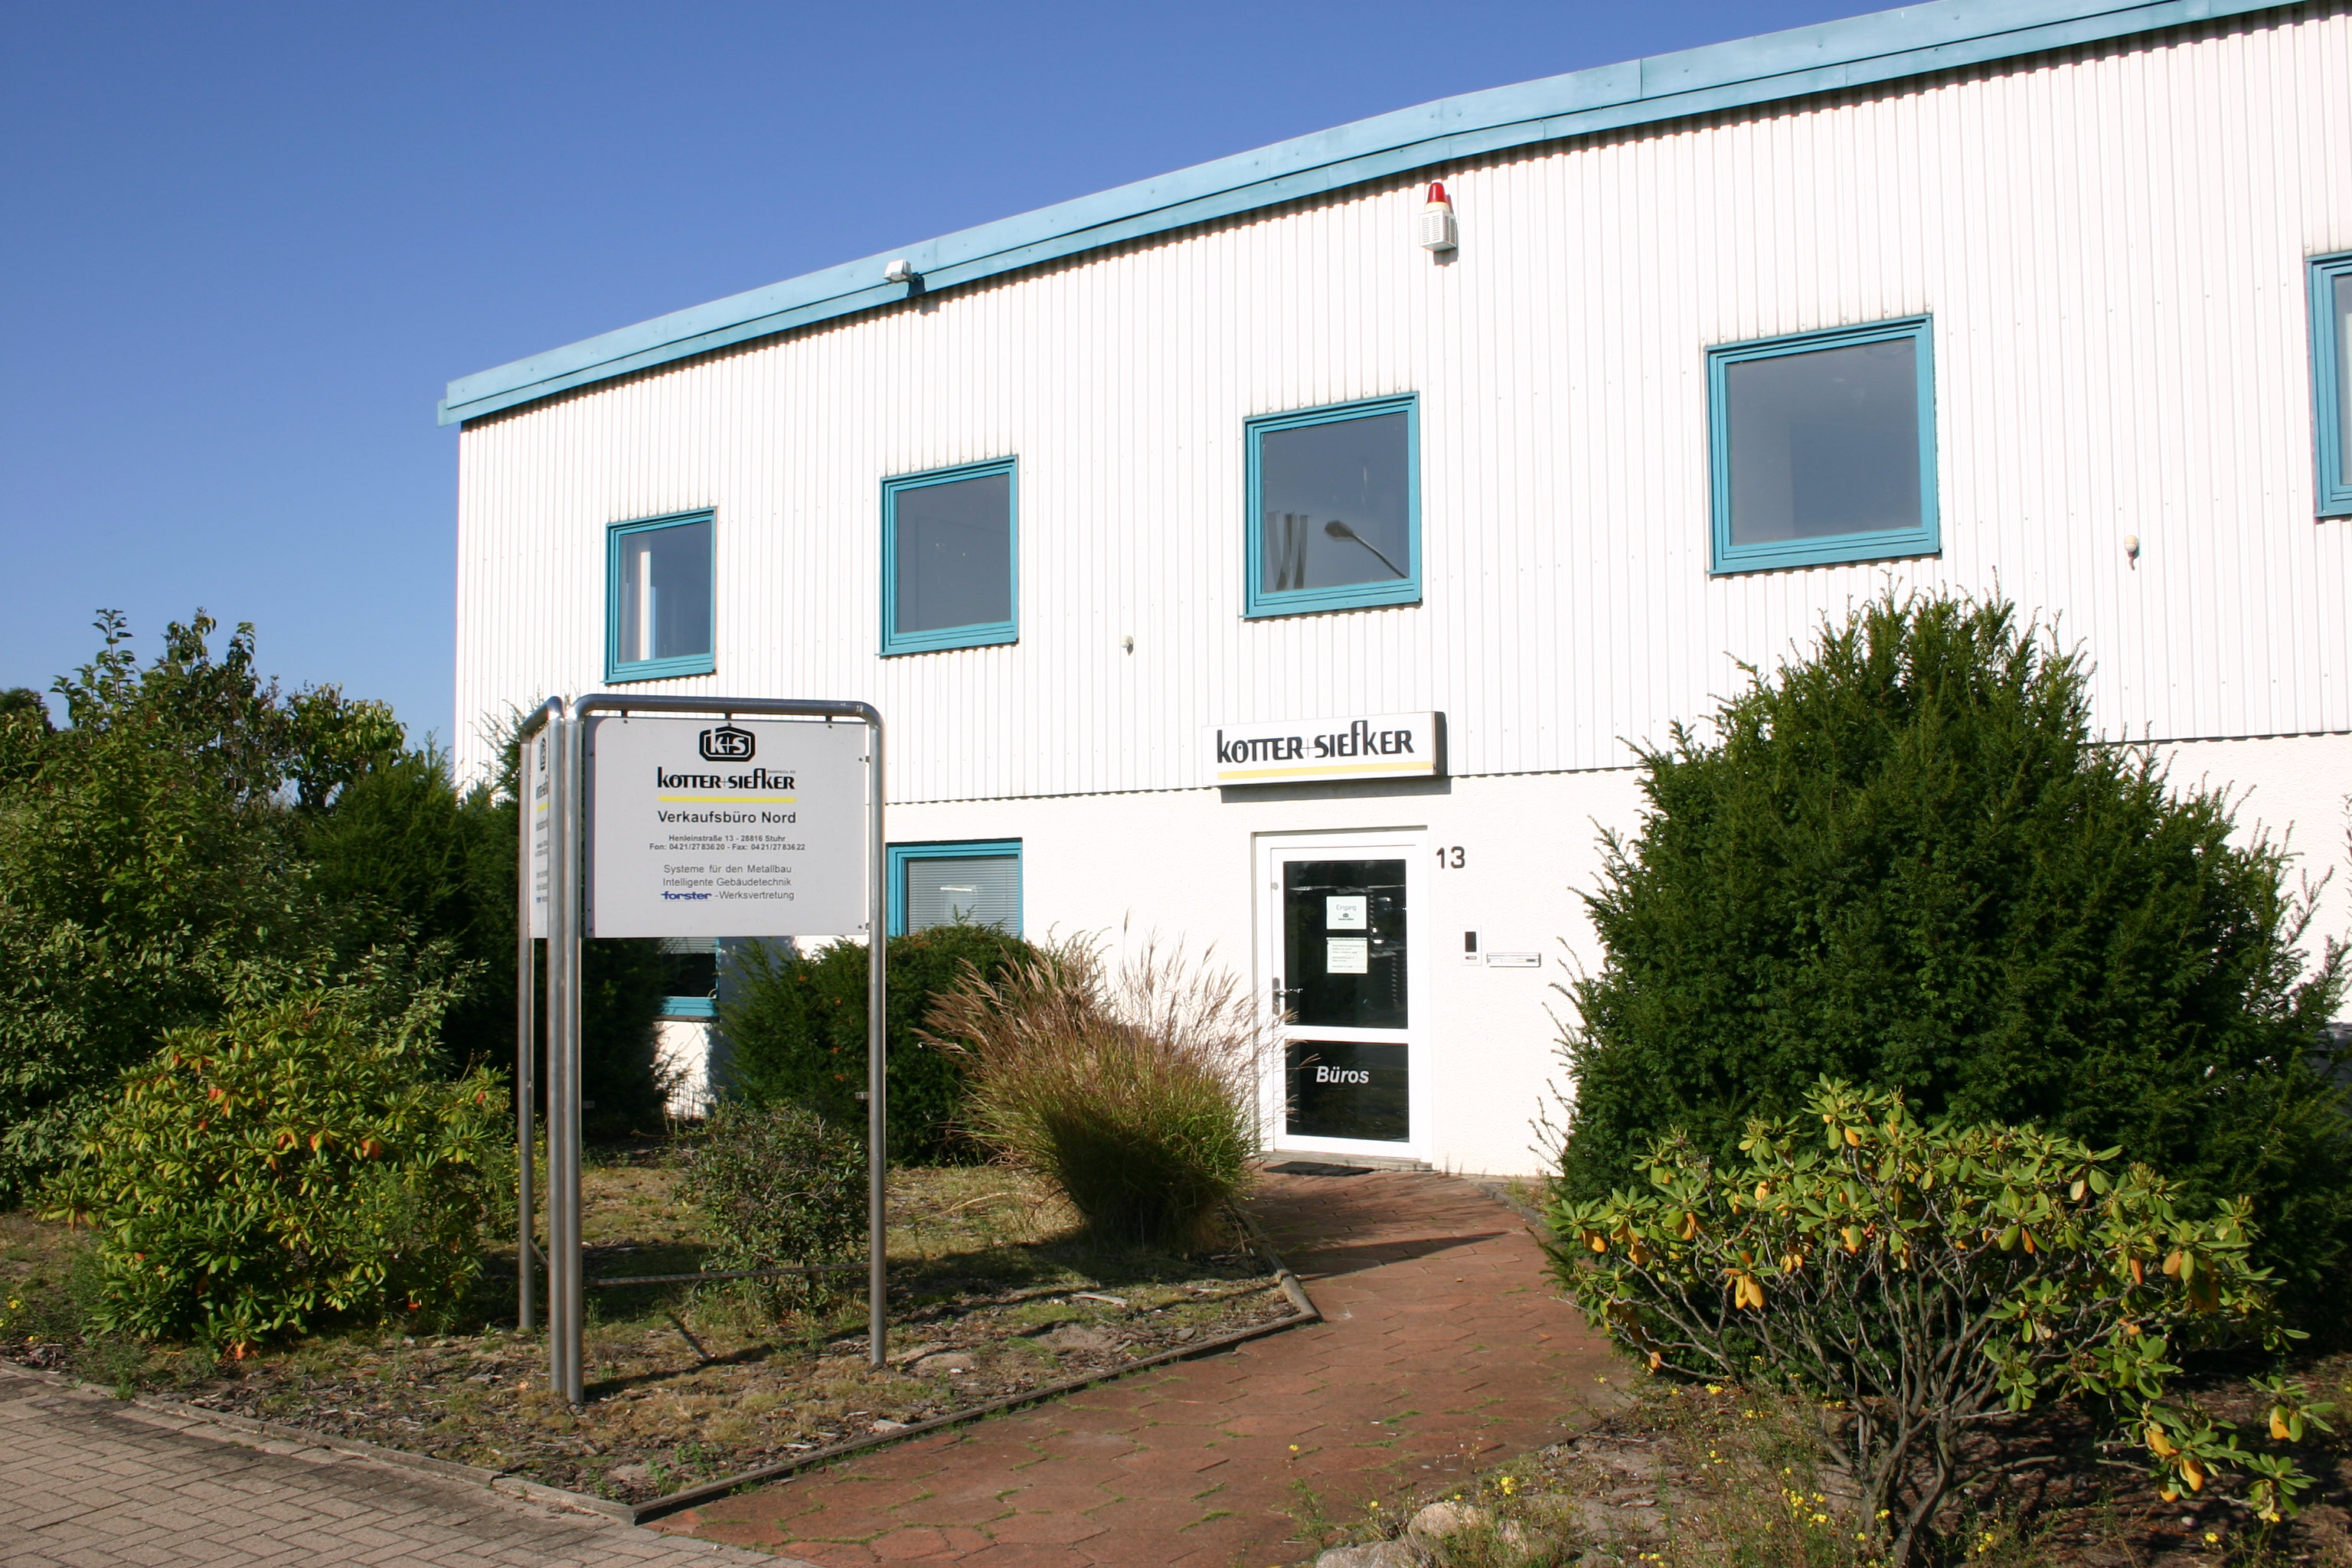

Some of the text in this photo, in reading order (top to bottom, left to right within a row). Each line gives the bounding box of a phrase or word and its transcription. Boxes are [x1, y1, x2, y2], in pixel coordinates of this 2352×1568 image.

[657, 810, 797, 824] Verkaufsbüro Nord
[1436, 845, 1465, 869] 13
[663, 864, 792, 875] Systeme für den Metallbau
[662, 877, 792, 888] Intelligente Gebäudetechnik
[660, 890, 712, 900] forster
[1315, 1065, 1370, 1084] Büros
